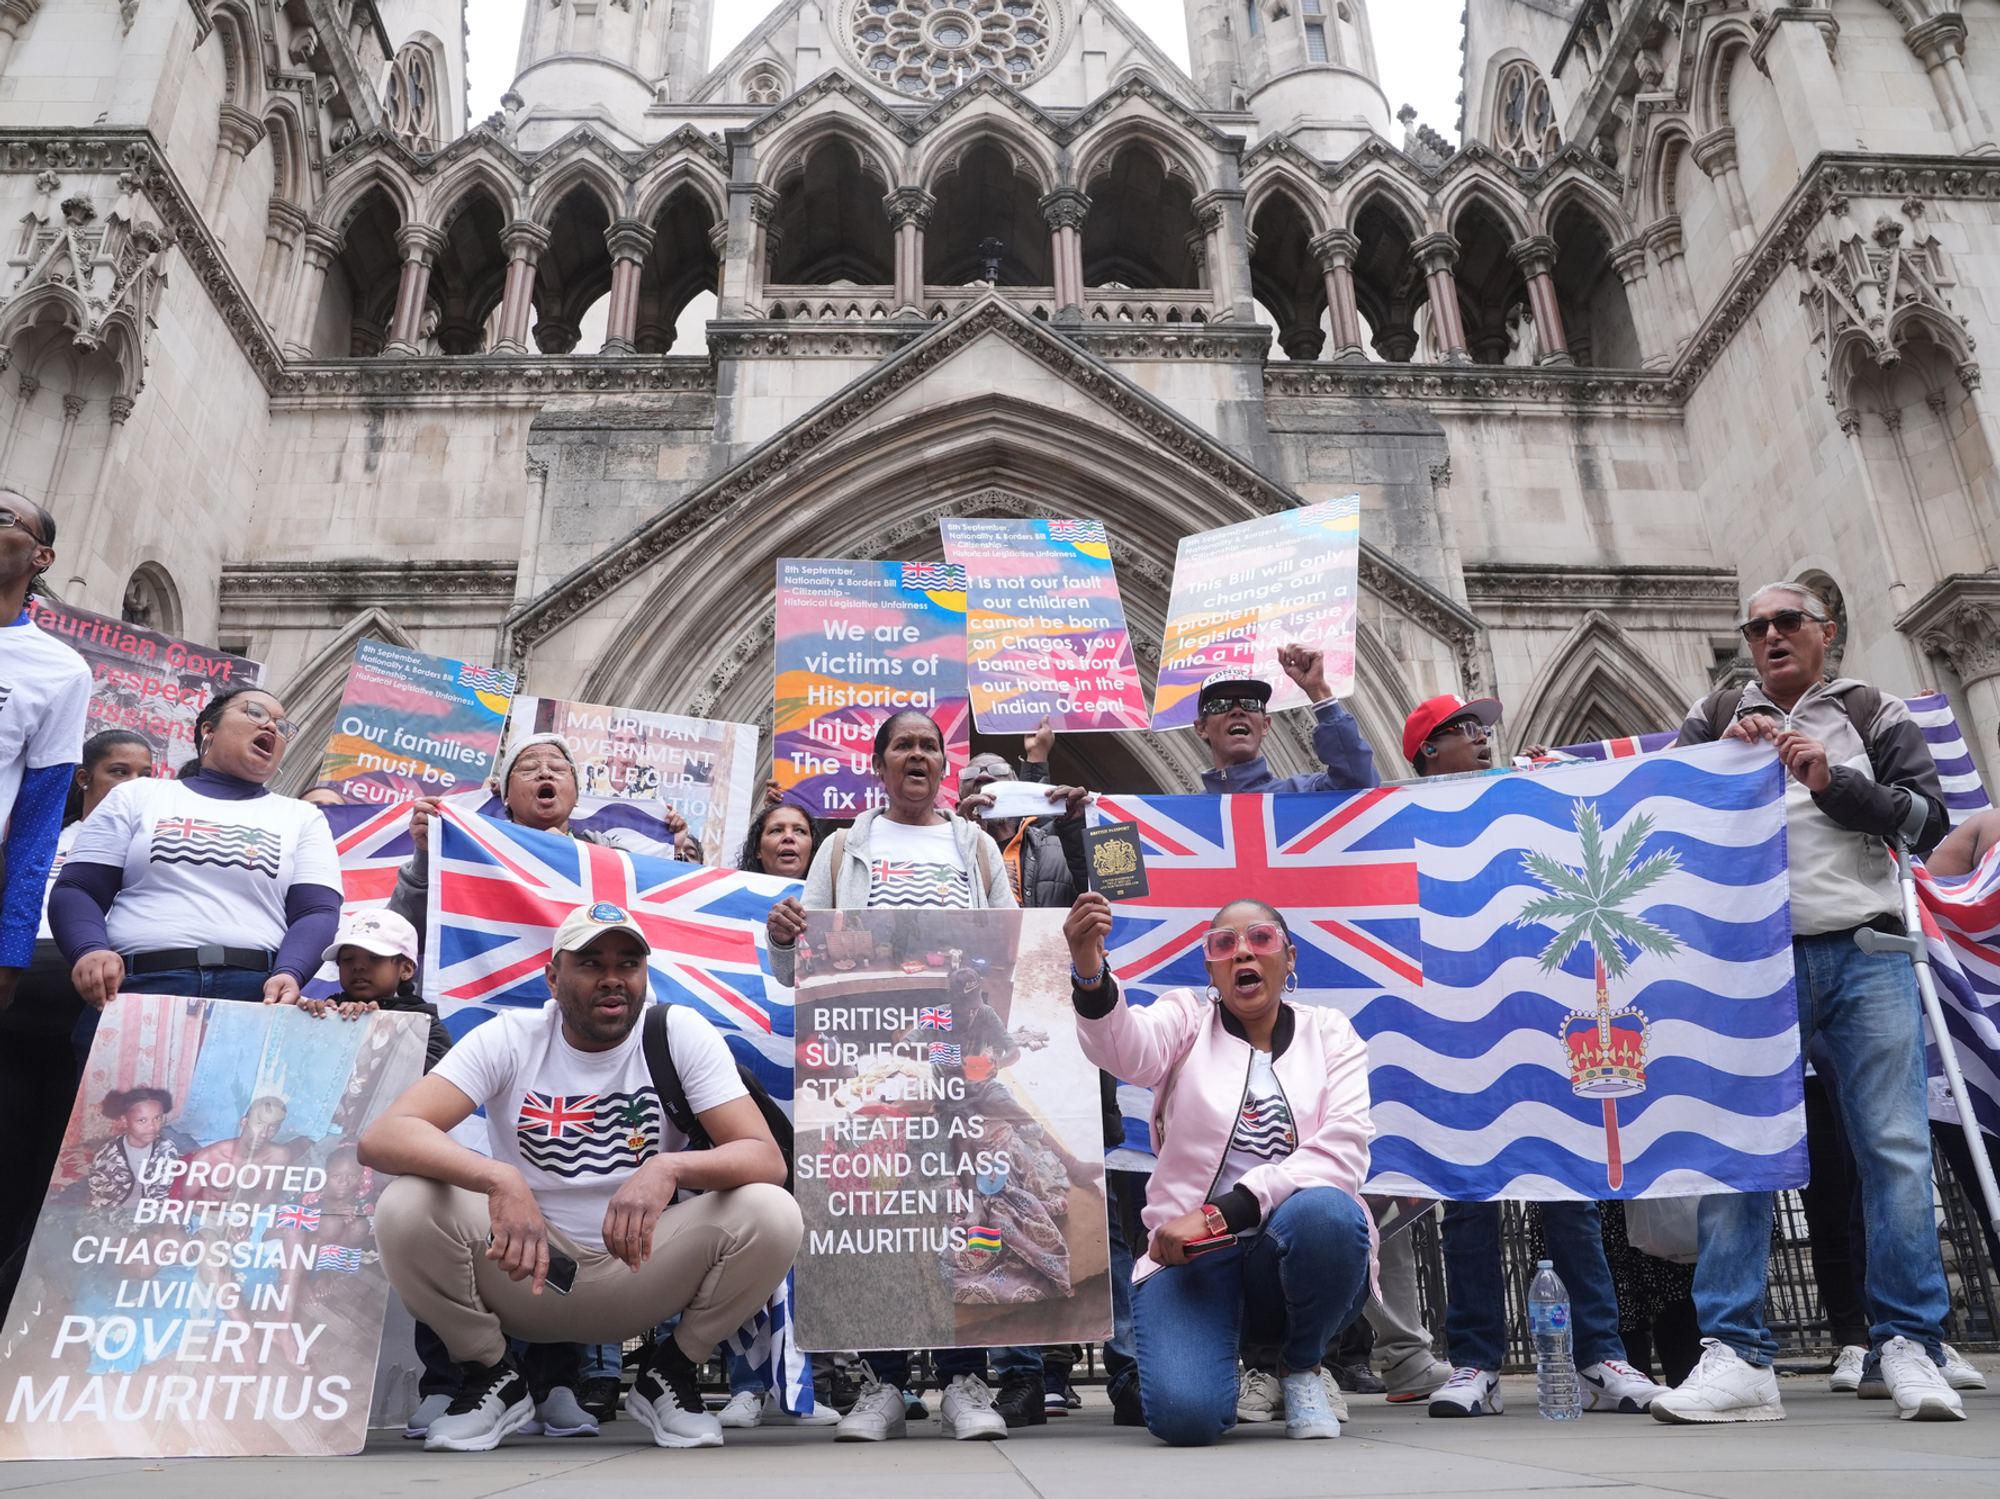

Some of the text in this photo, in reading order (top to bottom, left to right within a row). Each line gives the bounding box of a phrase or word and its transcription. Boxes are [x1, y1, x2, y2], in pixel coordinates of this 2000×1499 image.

[949, 532, 993, 541] Nationality
[962, 523, 1010, 532] September,
[1201, 526, 1253, 544] September,
[1275, 532, 1322, 547] Unfairness
[957, 541, 1002, 549] Citizenship
[992, 550, 1034, 558] Legislative
[1185, 540, 1233, 555] Nationality
[1244, 528, 1277, 541] Borders
[1191, 544, 1239, 560] Citizenship
[784, 565, 856, 576] 8th September,
[784, 576, 897, 588] Nationality & Borders Bill
[978, 575, 992, 589] is
[996, 575, 1025, 589] not
[1030, 577, 1058, 589] our
[1062, 575, 1101, 589] fault
[1187, 549, 1344, 595] This Bill will only
[792, 587, 843, 598] Citizenship
[982, 594, 1090, 609] our children
[1203, 572, 1325, 608] change our
[784, 598, 928, 610] Historical Legislative Unfairness
[1176, 585, 1348, 635] problems from a
[823, 619, 920, 643] We are
[970, 615, 1110, 630] cannot be born
[1178, 606, 1343, 650] legislative issue
[363, 645, 422, 666] 8th September,
[973, 635, 1116, 653] on Chagos, you
[1167, 624, 1351, 672] into a FINANCIAL
[166, 642, 233, 682] Govt
[360, 653, 403, 671] Nationality
[412, 666, 441, 680] Borders
[442, 674, 455, 682] Bill
[364, 664, 407, 681] Citizenship
[804, 651, 939, 676] victims of
[977, 656, 1120, 672] banned us from
[94, 663, 208, 710] respect
[355, 671, 475, 706] Historical Legislative Unfairness
[808, 685, 936, 708] Historical
[982, 676, 1125, 692] our home in the
[991, 697, 1125, 715] Indian Ocean!
[567, 711, 701, 743] MAURITIAN
[341, 716, 488, 767] Our families
[566, 735, 716, 769] OVERNMENT
[356, 752, 456, 788] must be
[578, 761, 694, 791] TOLE OUR
[790, 752, 841, 775] The
[823, 786, 856, 809] fix
[814, 1006, 919, 1032] BRITISH
[806, 1042, 928, 1067] SUBJECT
[885, 1076, 966, 1101] BEING
[818, 1115, 985, 1141] TREATED AS
[137, 1158, 327, 1193] UPROOTED
[797, 1150, 1011, 1179] SECOND CLASS
[134, 1198, 277, 1228] BRITISH
[828, 1188, 974, 1217] CITIZEN IN
[71, 1235, 317, 1271] CHAGOSSIAN
[809, 1226, 968, 1255] MAURITIUS
[114, 1279, 290, 1312] LIVING IN
[50, 1314, 327, 1365] POVERTY
[5, 1375, 351, 1423] MAURITIUS
